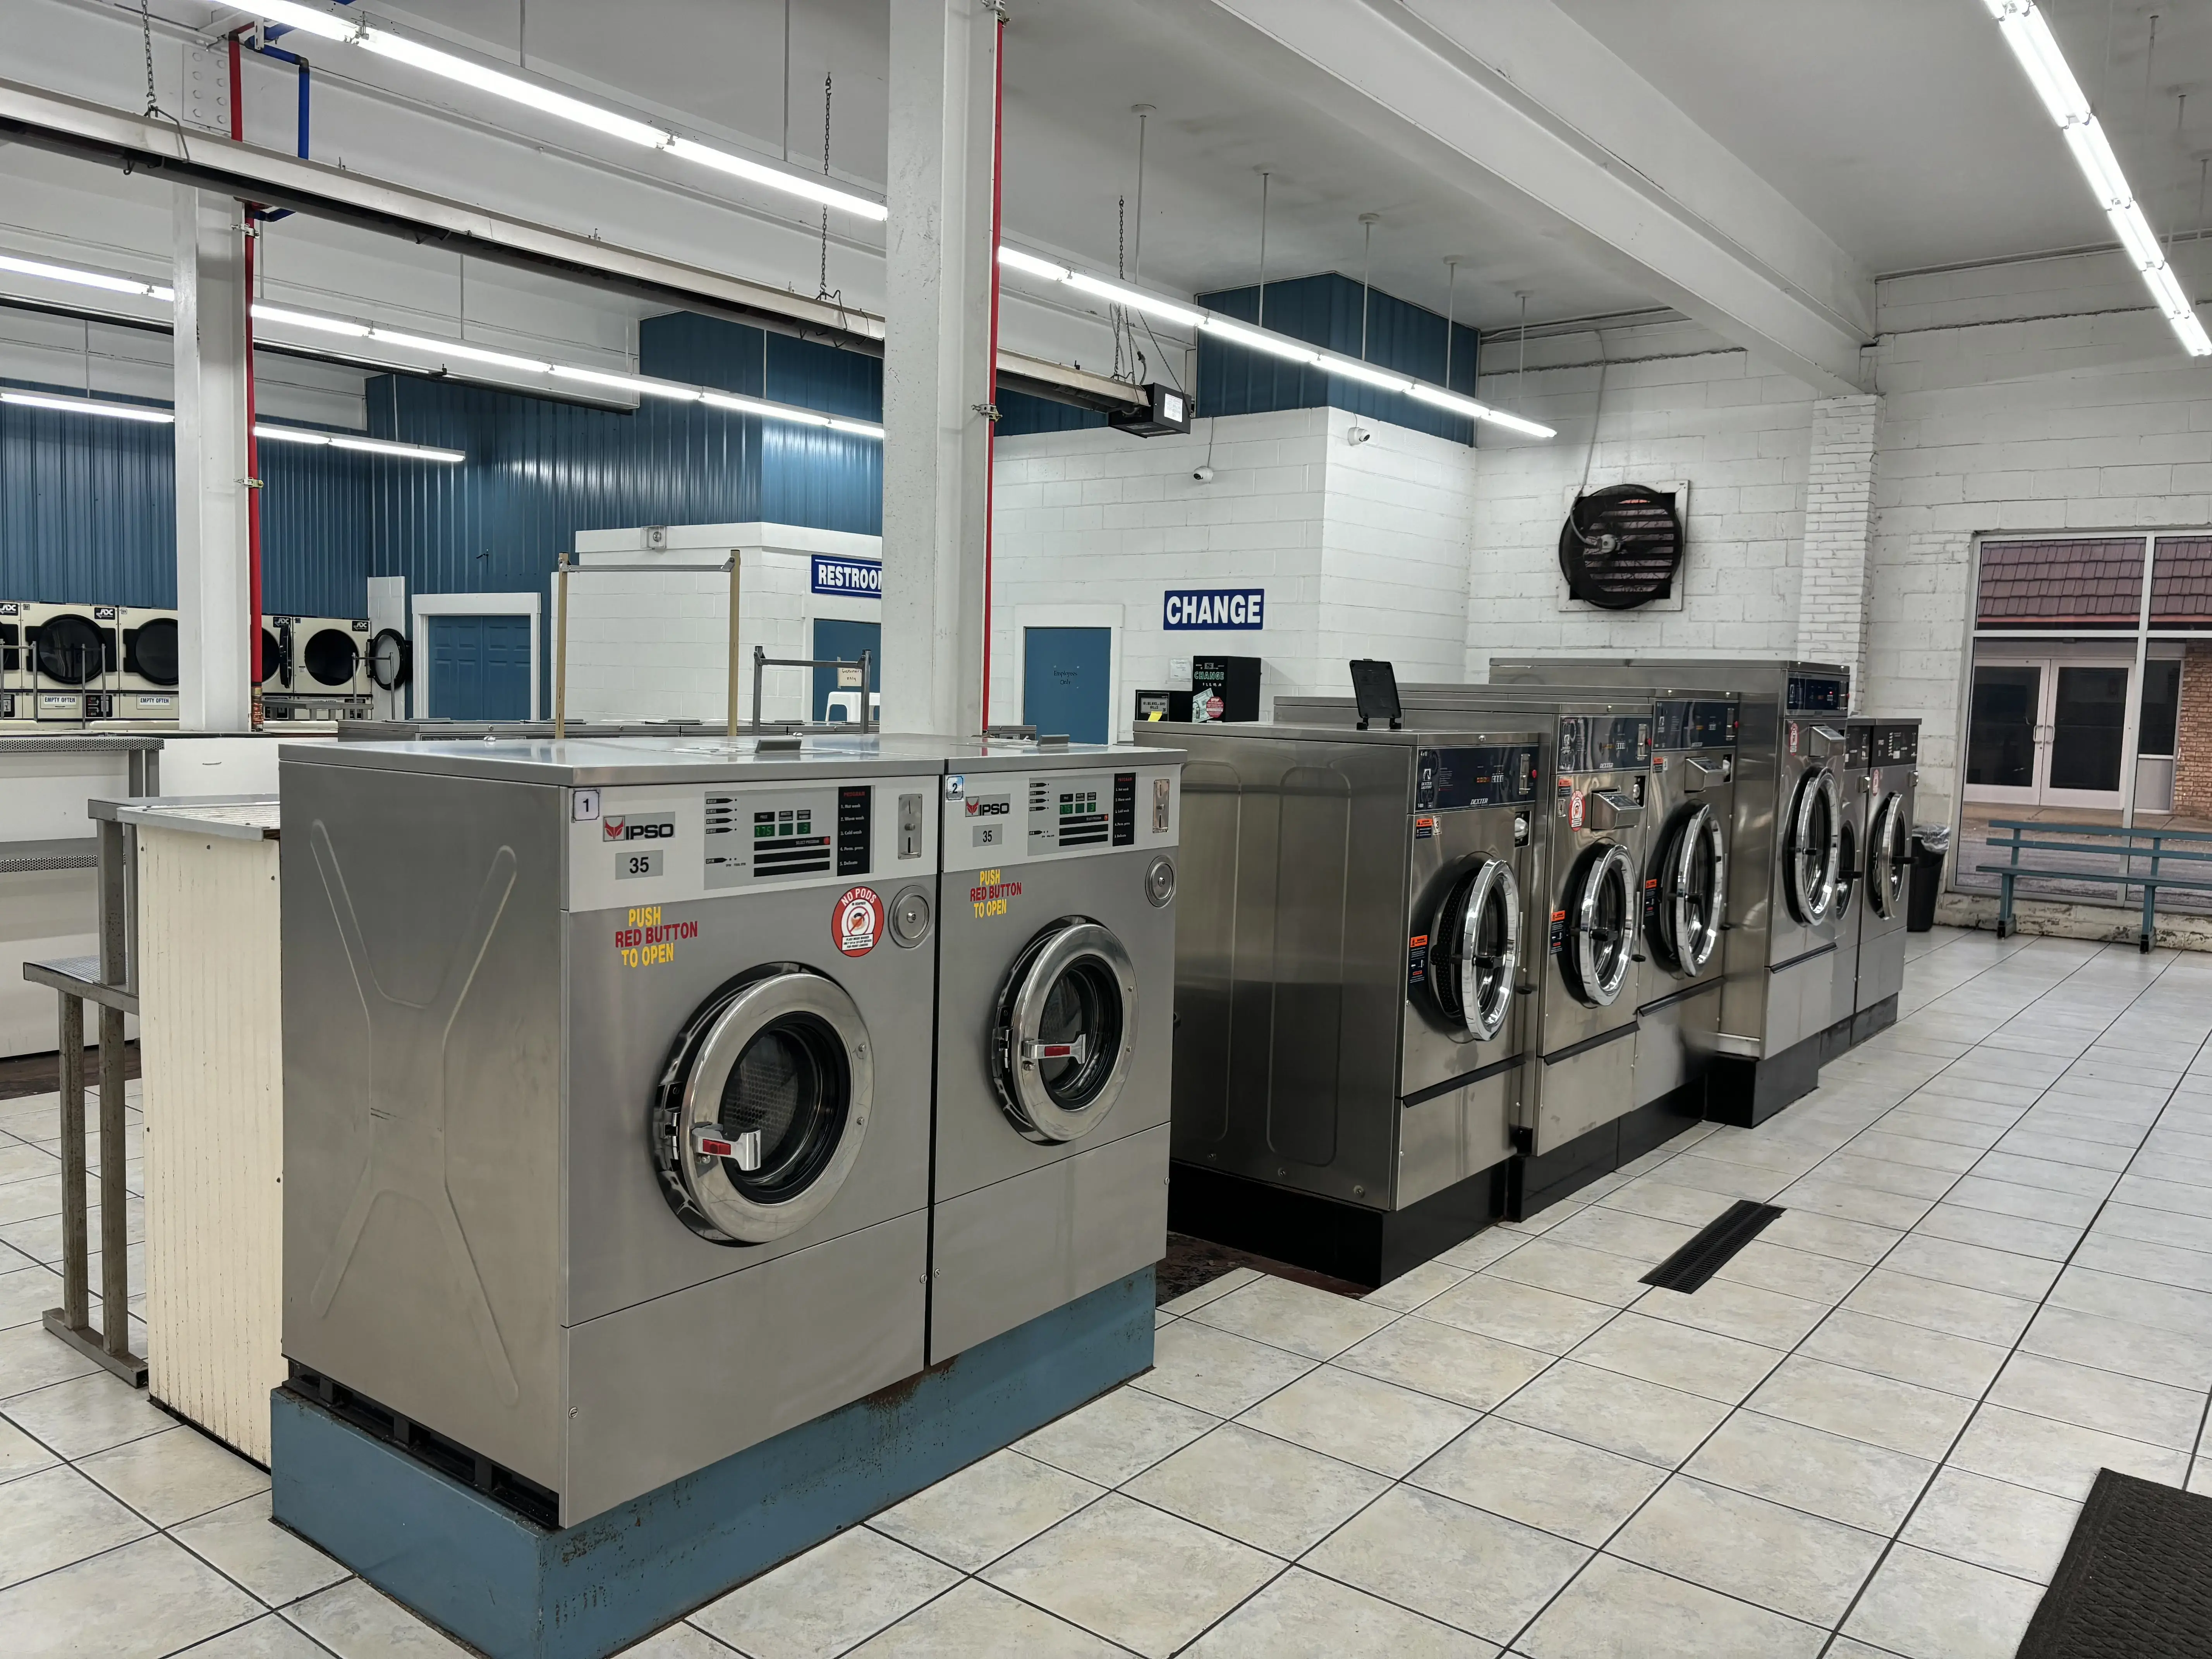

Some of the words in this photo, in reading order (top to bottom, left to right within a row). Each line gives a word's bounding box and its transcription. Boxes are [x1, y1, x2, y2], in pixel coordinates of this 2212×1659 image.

[1166, 594, 1261, 624] CHANGE
[1194, 671, 1224, 680] CHANGE
[952, 783, 958, 793] 2
[583, 799, 589, 812] 1
[979, 803, 1010, 816] IPSO
[626, 823, 674, 840] IPSO
[804, 824, 808, 833] 3
[1436, 821, 1439, 829] 3
[983, 830, 992, 842] 35
[629, 857, 649, 874] 35
[980, 869, 1000, 886] PUSH
[841, 891, 854, 907] NO
[855, 888, 877, 904] PODS
[970, 886, 987, 902] RED
[989, 882, 1022, 899] BUTTON
[629, 906, 661, 927] PUSH
[974, 902, 984, 918] TO
[986, 898, 1007, 917] OPEN
[615, 929, 642, 948] RED
[646, 921, 698, 944] BUTTON
[621, 948, 638, 968] TO
[642, 942, 674, 966] OPEN
